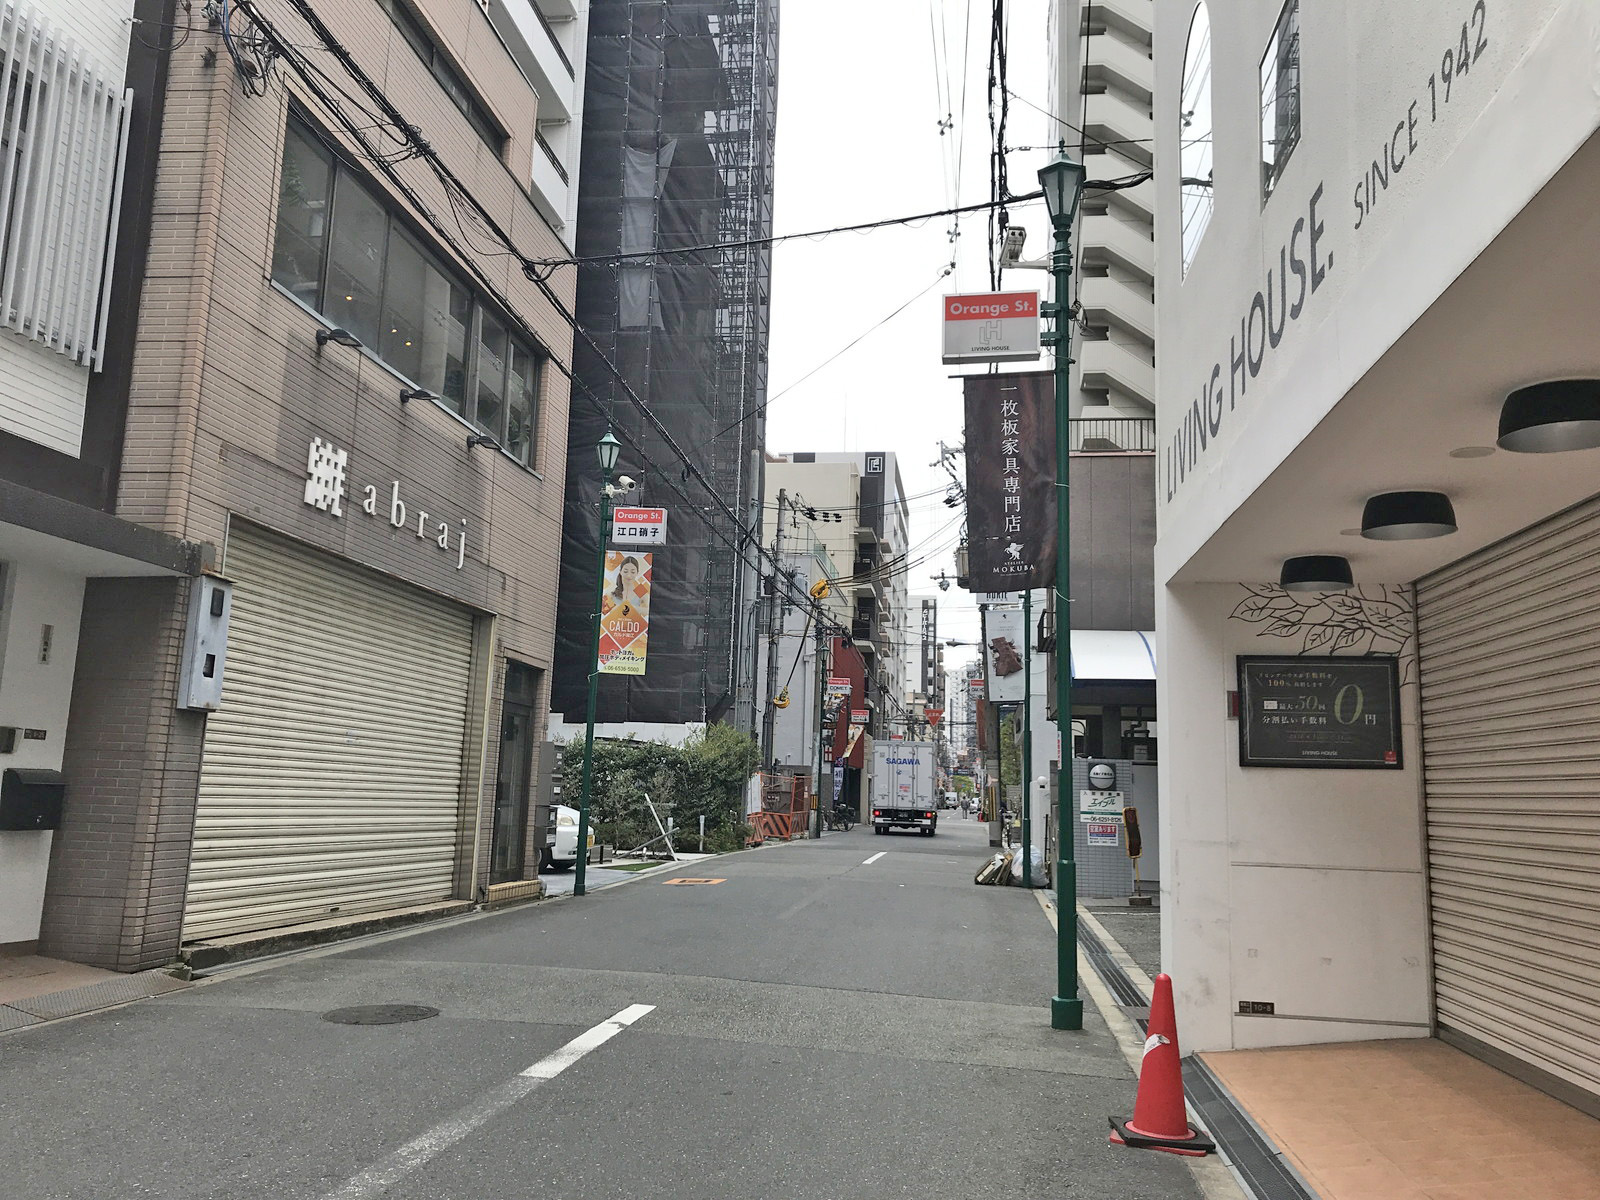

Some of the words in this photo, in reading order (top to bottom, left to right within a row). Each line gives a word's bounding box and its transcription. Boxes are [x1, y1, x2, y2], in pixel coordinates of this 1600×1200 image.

[1354, 99, 1418, 230] SINCE
[1428, 0, 1488, 123] 1942
[950, 302, 1009, 317] Orange
[1014, 300, 1034, 312] St.
[1167, 363, 1223, 504] LIVING
[1230, 180, 1334, 412] HOUSE.
[1000, 385, 1022, 534] 一枚板家具専門店
[617, 511, 649, 521] Orange
[650, 511, 661, 520] St.
[362, 480, 467, 570] abraj
[617, 526, 660, 537] 江口硝子
[992, 564, 1035, 573] MOKUBA
[609, 620, 640, 633] CALDO
[885, 757, 921, 766] SAGAWA
[1088, 796, 1117, 808] エイブル
